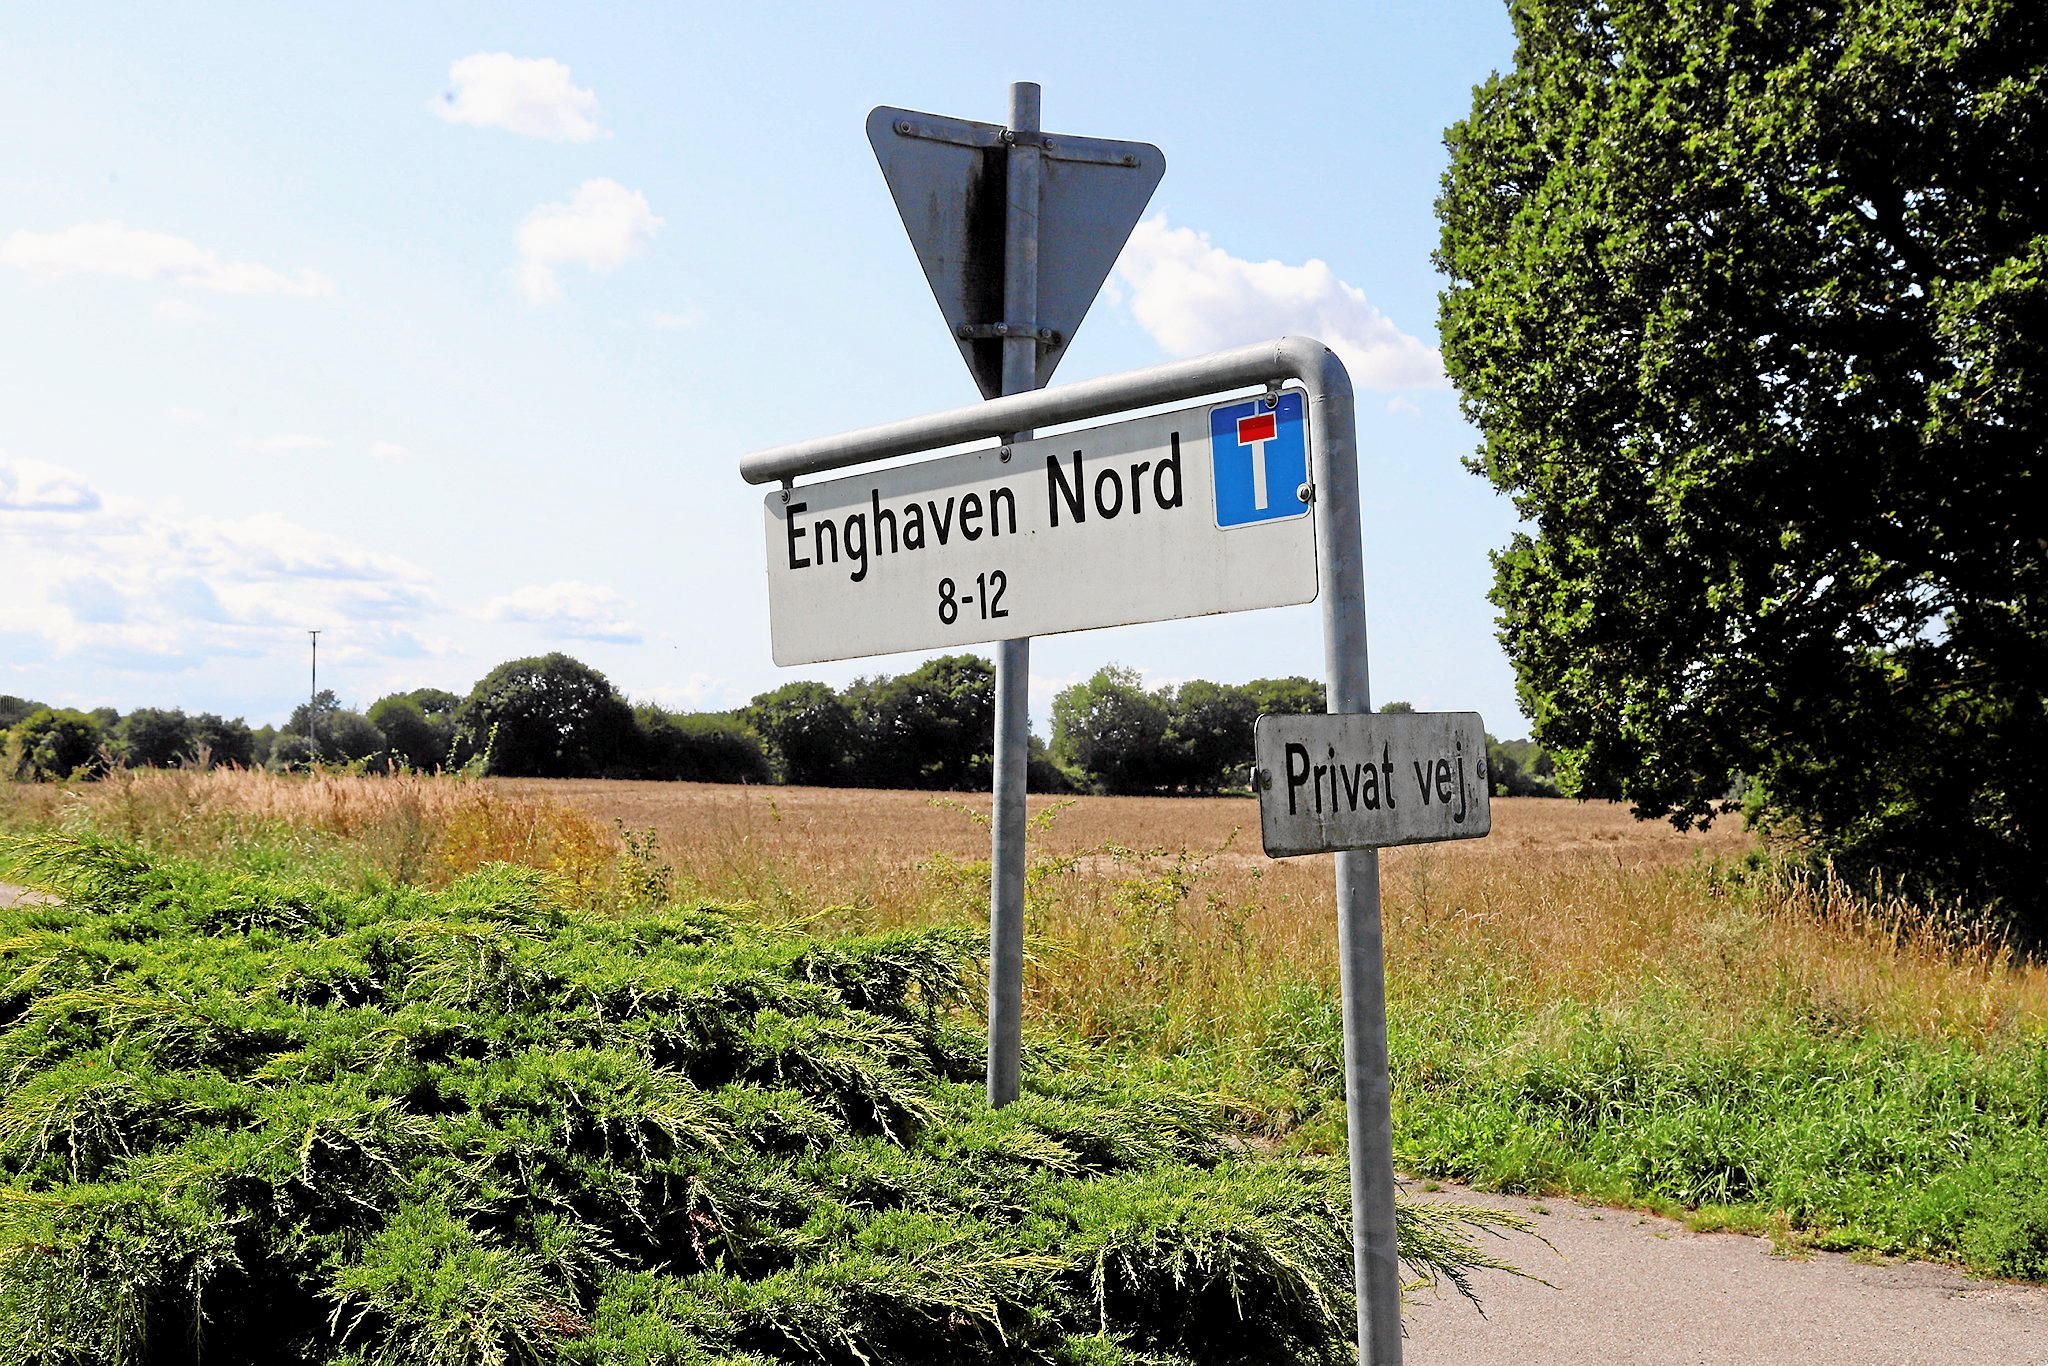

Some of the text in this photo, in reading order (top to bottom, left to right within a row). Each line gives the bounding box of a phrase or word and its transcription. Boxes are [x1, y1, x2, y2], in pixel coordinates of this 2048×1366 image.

[785, 431, 1183, 582] Enghaven Nord
[938, 569, 1009, 625] 8-12
[1285, 739, 1466, 824] Privat vej
